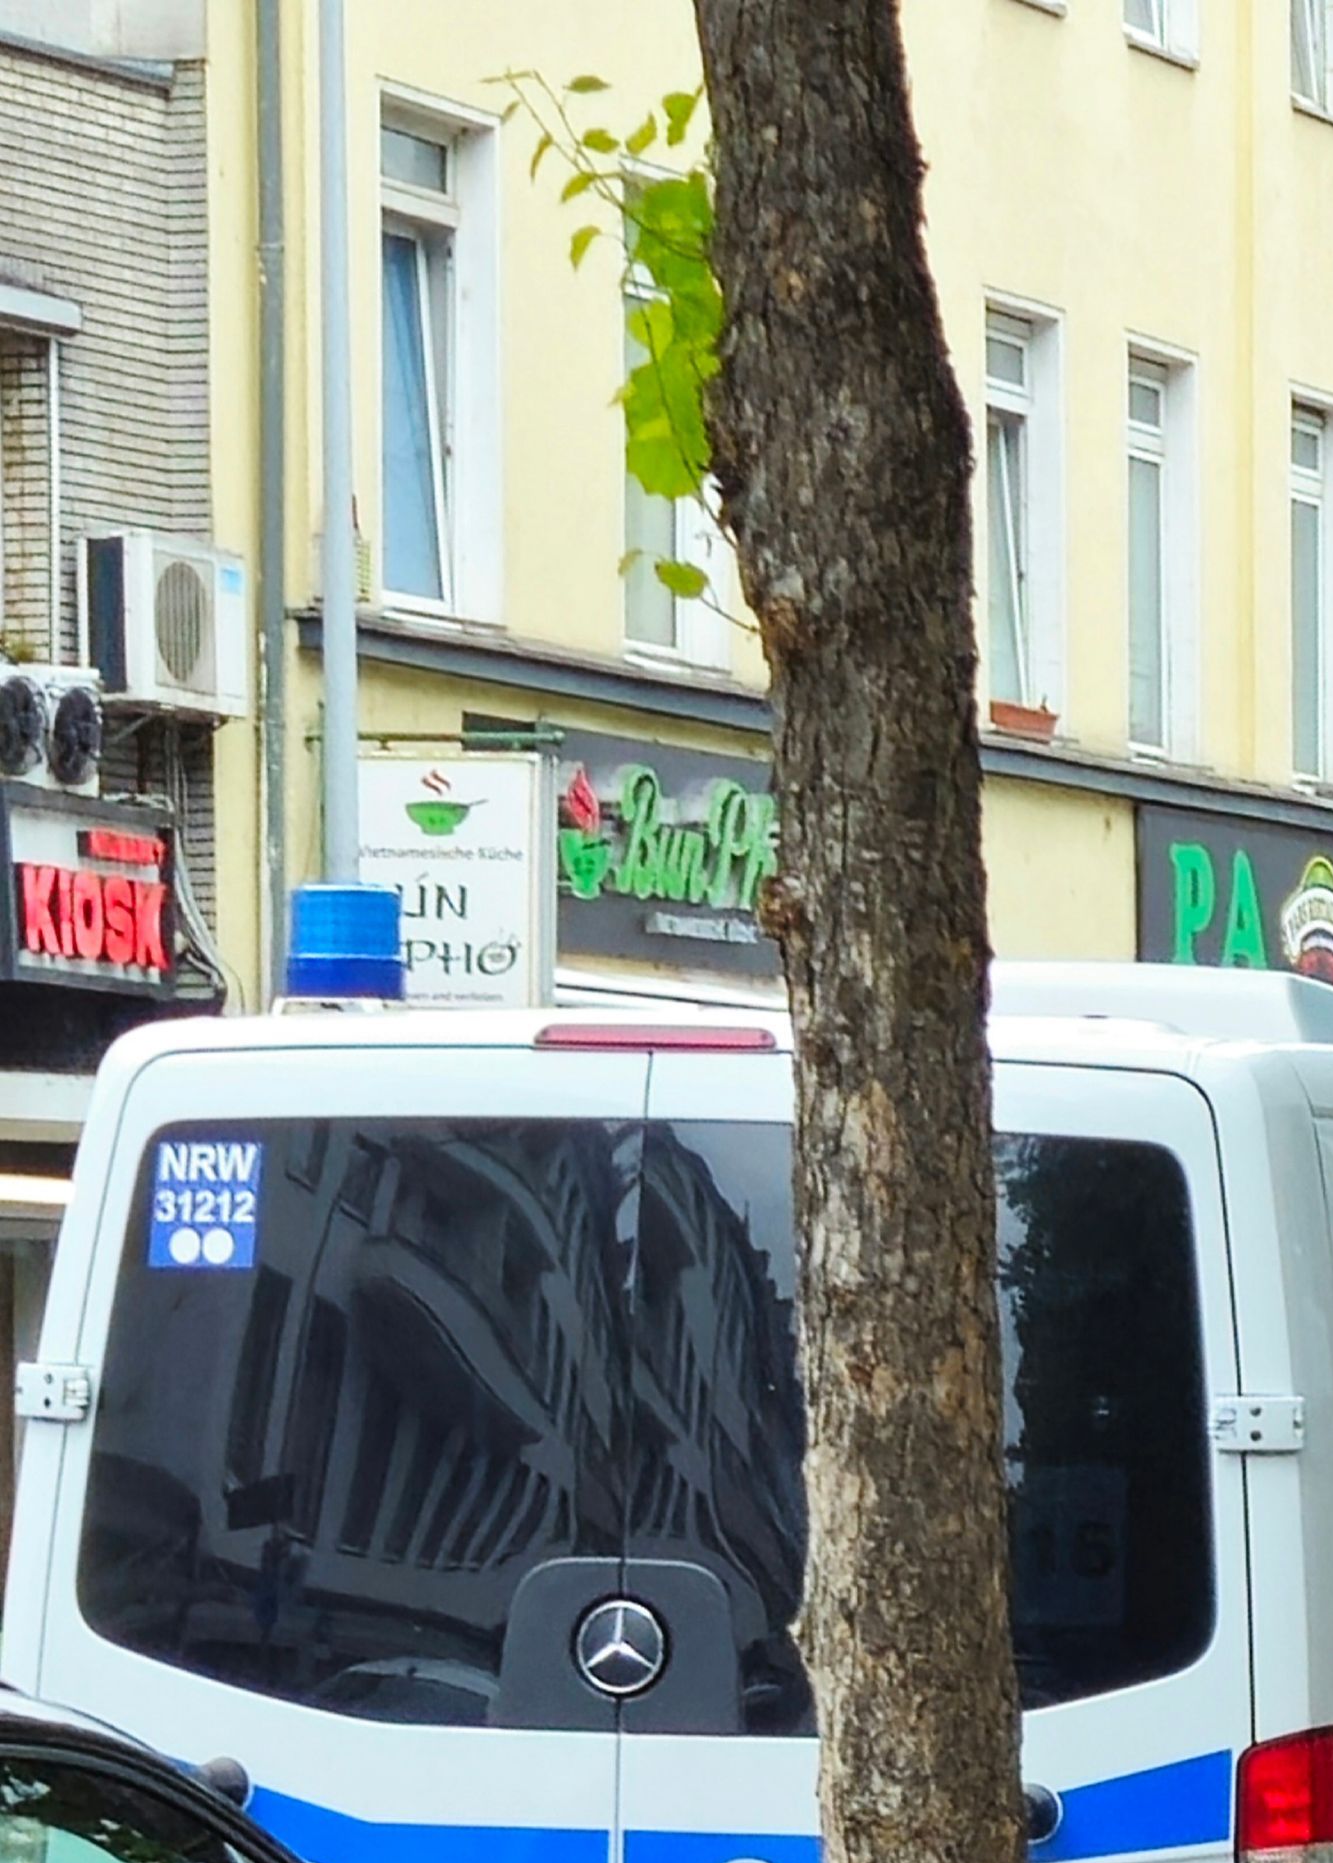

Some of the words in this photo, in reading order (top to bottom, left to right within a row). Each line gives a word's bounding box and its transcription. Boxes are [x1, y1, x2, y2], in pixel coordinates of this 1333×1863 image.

[22, 864, 169, 970] KIOSK
[159, 1142, 258, 1182] NRW
[155, 1189, 255, 1223] 31212
